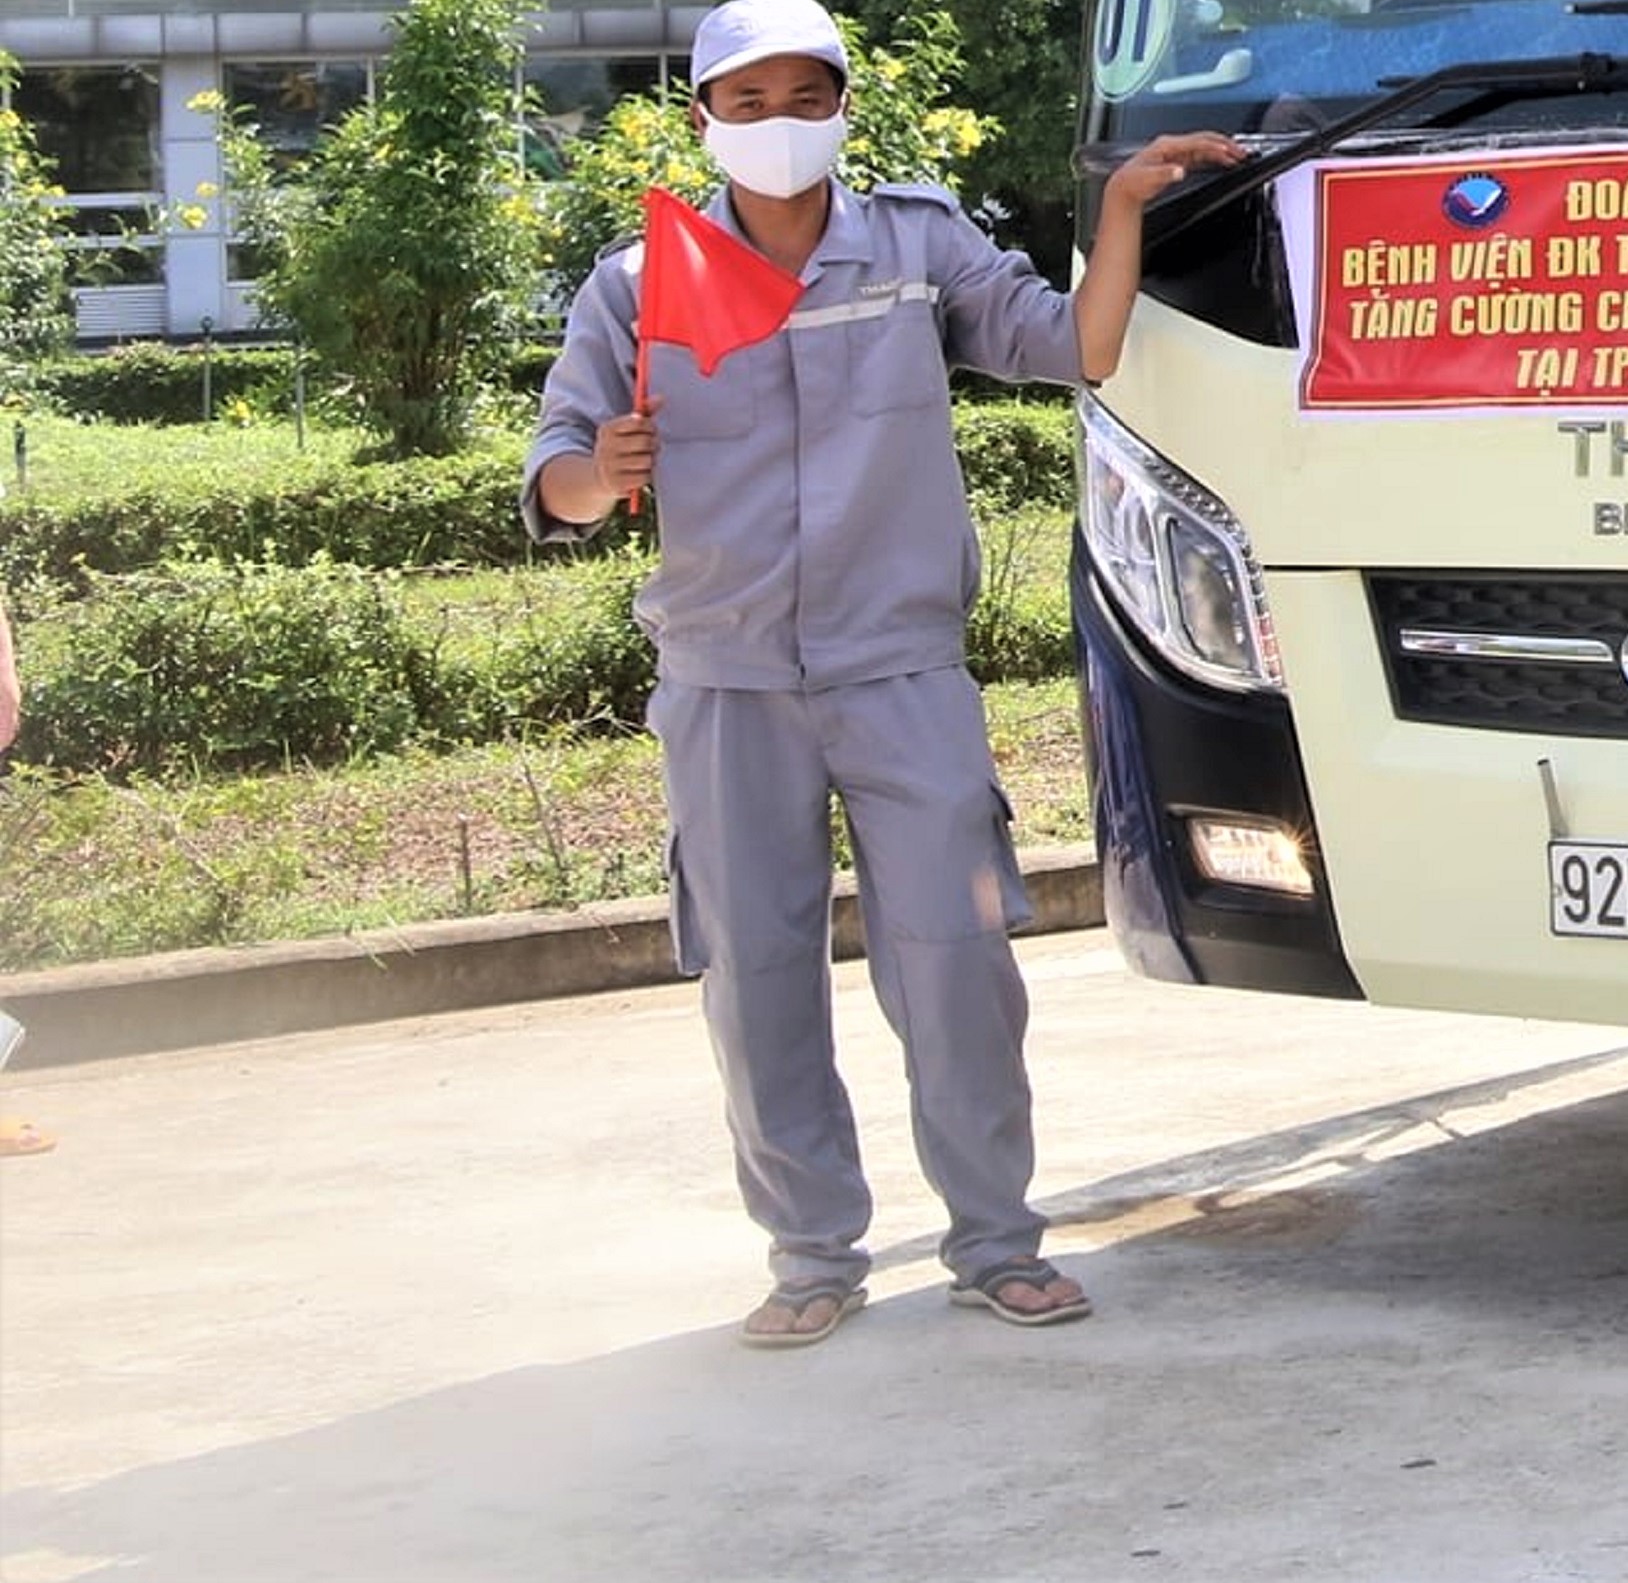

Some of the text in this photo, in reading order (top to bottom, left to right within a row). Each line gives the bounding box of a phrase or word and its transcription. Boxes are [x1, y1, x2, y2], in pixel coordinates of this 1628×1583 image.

[1342, 239, 1437, 289] BỆNH
[1451, 233, 1533, 290] VIỆN
[1547, 236, 1602, 279] ĐK
[1350, 288, 1439, 340] TĂNG
[1450, 287, 1583, 336] CƯỜNG
[1515, 348, 1580, 396] TẠI
